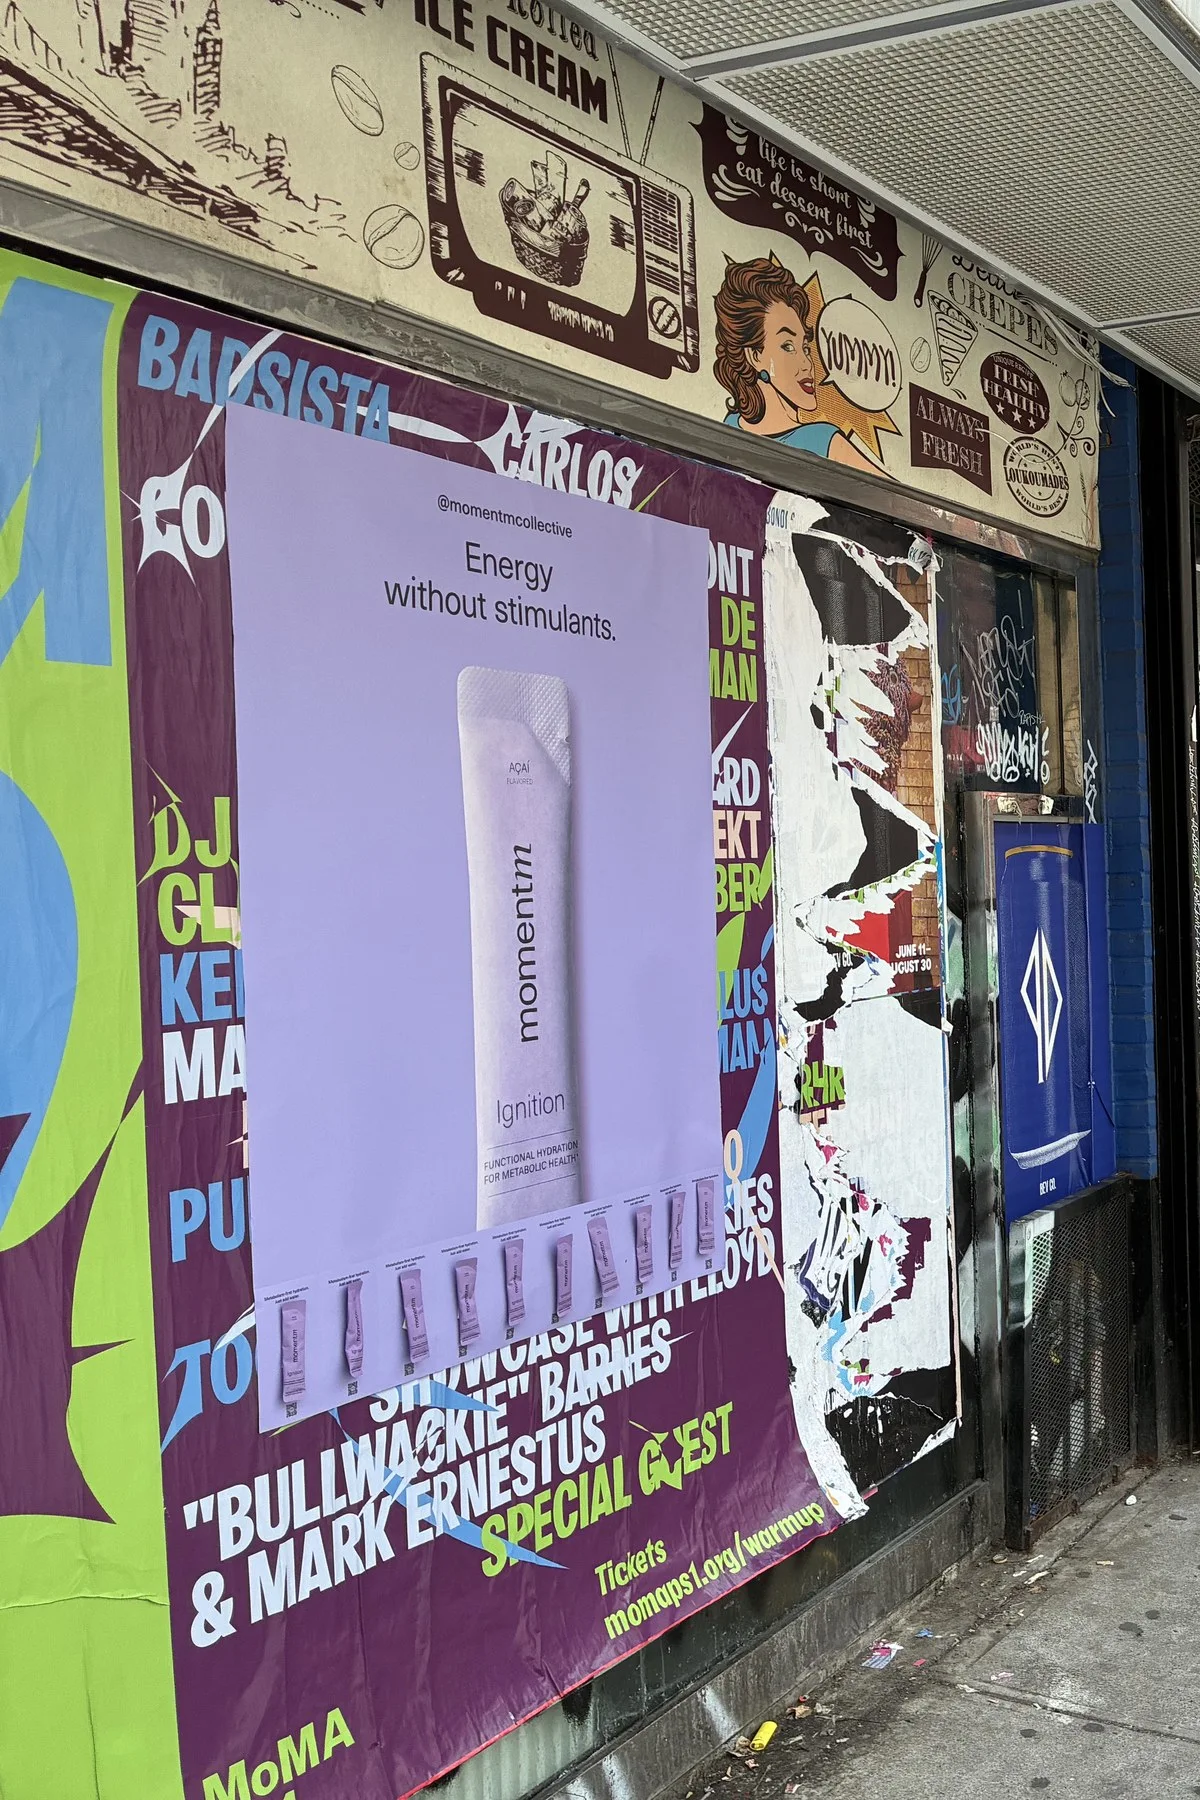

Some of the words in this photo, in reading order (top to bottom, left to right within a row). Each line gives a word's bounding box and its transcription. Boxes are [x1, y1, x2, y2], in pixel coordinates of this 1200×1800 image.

[486, 14, 608, 125] CREAM
[758, 136, 787, 169] life
[790, 159, 806, 183] is
[809, 171, 852, 209] short
[736, 161, 766, 188] eat
[770, 173, 833, 226] dessert
[836, 213, 874, 249] first
[947, 271, 1059, 356] CREPES
[138, 314, 391, 444] BADSISTA
[821, 326, 897, 388] YUMMY!
[993, 354, 1016, 370] UNIQUE
[1014, 361, 1036, 382] RECIPE
[993, 363, 1041, 399] FRESH
[916, 394, 985, 444] ALWAYS
[983, 377, 1048, 422] HEALTHY
[488, 402, 644, 511] CARLOS
[920, 430, 984, 477] FRESH
[1004, 466, 1070, 492] LOUKOUMADES
[1008, 441, 1040, 465] WORLD'S
[437, 493, 574, 539] @momentmcollective
[1015, 487, 1049, 512] WORLD'S
[1047, 494, 1064, 512] BEST
[465, 540, 554, 593] Energy
[384, 575, 488, 621] without
[494, 594, 617, 642] stimulants.
[720, 596, 757, 650] DE
[509, 757, 531, 776] AÇAÍ
[145, 796, 233, 870] DJ
[511, 842, 539, 1043] momentm
[895, 943, 917, 959] JUNE
[920, 957, 932, 972] 30
[497, 1091, 565, 1129] Ignition
[483, 1173, 501, 1186] FOR
[501, 1160, 548, 1181] METABOLIC
[484, 1149, 535, 1172] FUNCTIONAL
[536, 1139, 580, 1159] HYDRATION
[1039, 1180, 1049, 1196] BEV
[539, 1318, 676, 1424] BARNES
[190, 1570, 237, 1648] &
[247, 1494, 396, 1625] MARK
[405, 1404, 606, 1550] ERNESTUS
[480, 1455, 632, 1577] SPECIAL
[594, 1538, 667, 1597] Tickets
[603, 1501, 826, 1640] momaps1.org/warmup
[202, 1706, 355, 1800] MoMA
